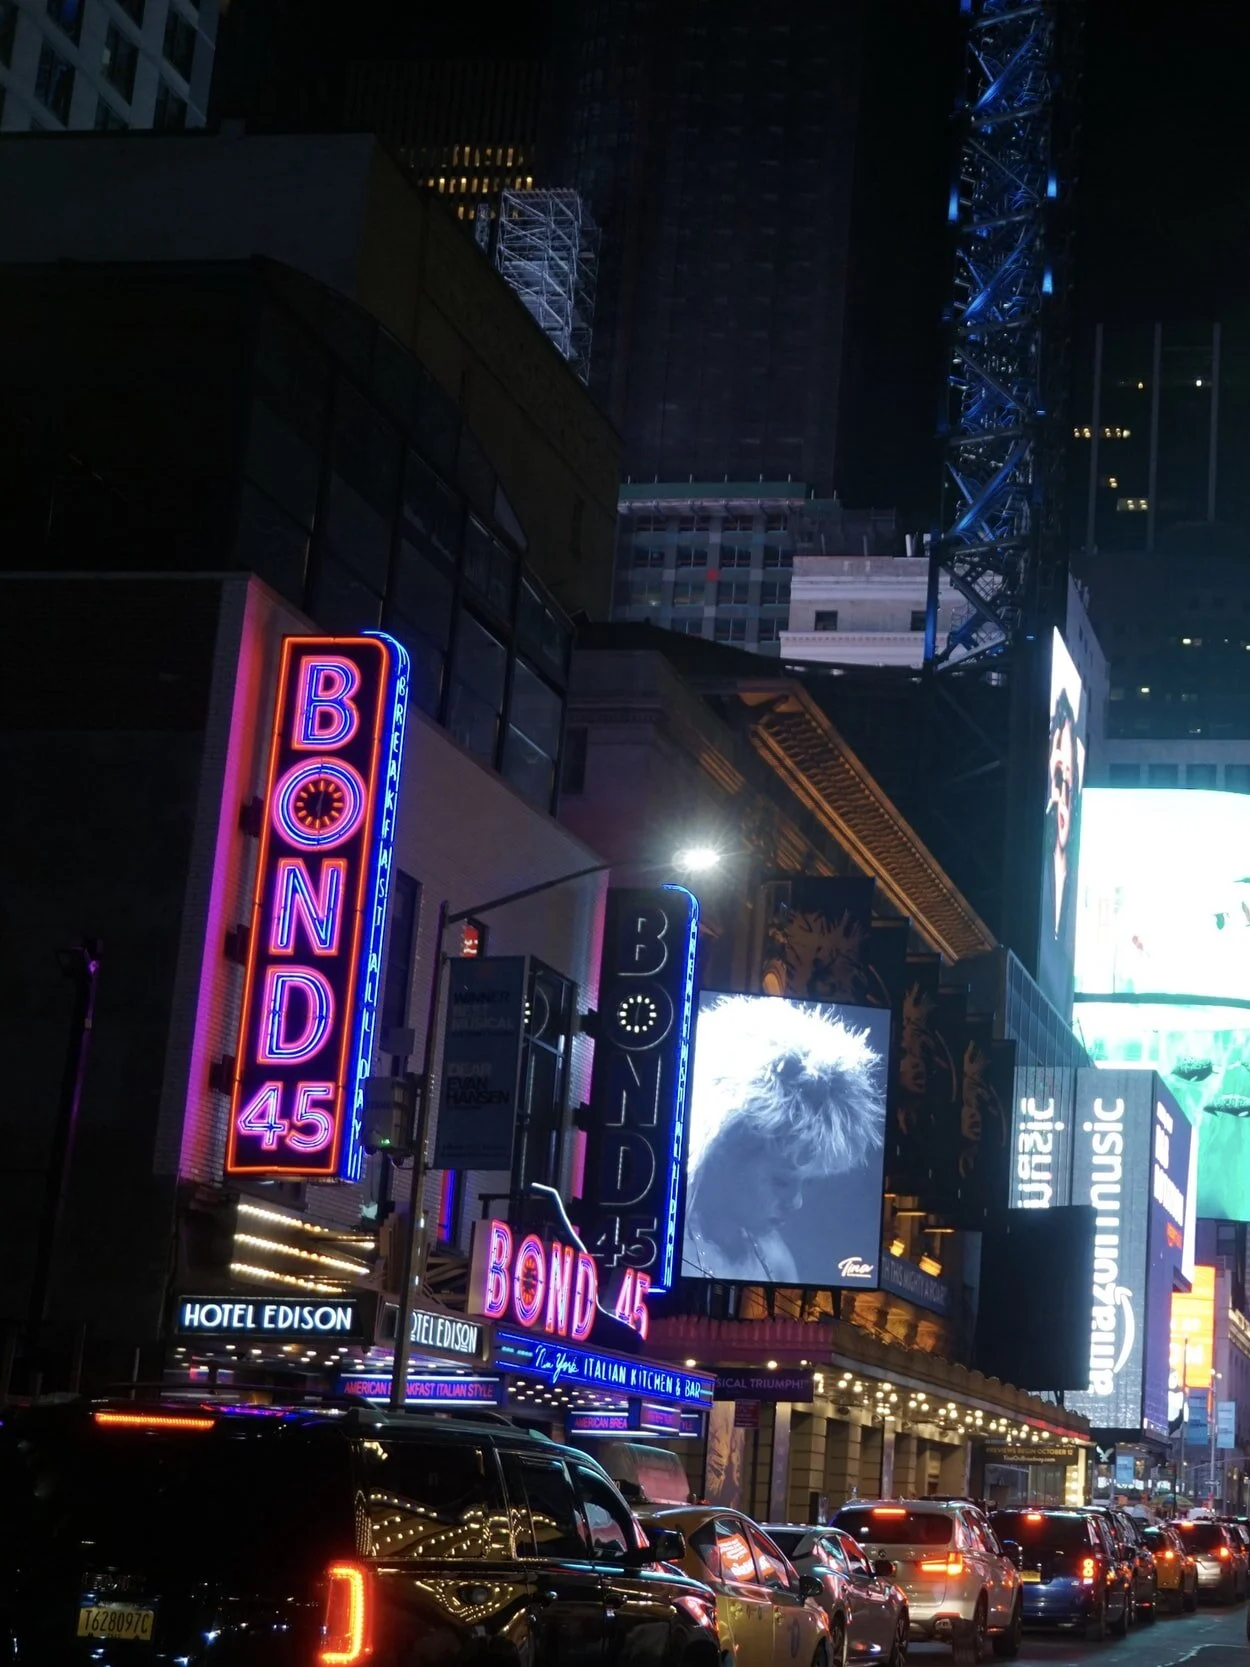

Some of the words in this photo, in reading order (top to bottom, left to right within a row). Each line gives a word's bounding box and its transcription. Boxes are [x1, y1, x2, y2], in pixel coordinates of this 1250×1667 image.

[256, 655, 368, 1066] BOND
[453, 990, 511, 1005] WINNER
[451, 1016, 515, 1032] MUSICAL
[597, 907, 676, 1207] BOND
[447, 1061, 493, 1077] DEAR
[447, 1076, 489, 1091] EVAN
[446, 1089, 511, 1105] HANSEN
[237, 1081, 335, 1152] 45
[837, 1256, 874, 1277] Tina
[484, 1219, 597, 1341] BOND
[614, 1268, 652, 1340] 45
[183, 1303, 257, 1329] HOTEL
[263, 1305, 353, 1331] EDISON
[410, 1311, 434, 1345] OTEL
[436, 1318, 478, 1354] EDISON
[552, 1352, 580, 1384] York
[583, 1357, 627, 1386] ITALIAN
[630, 1366, 674, 1394] KITCHEN
[684, 1380, 702, 1399] BAR
[343, 1379, 388, 1396] AMERICAN
[437, 1383, 467, 1398] ITALIAN
[467, 1384, 494, 1398] STYLE
[1036, 1448, 1067, 1456] OCTOBER
